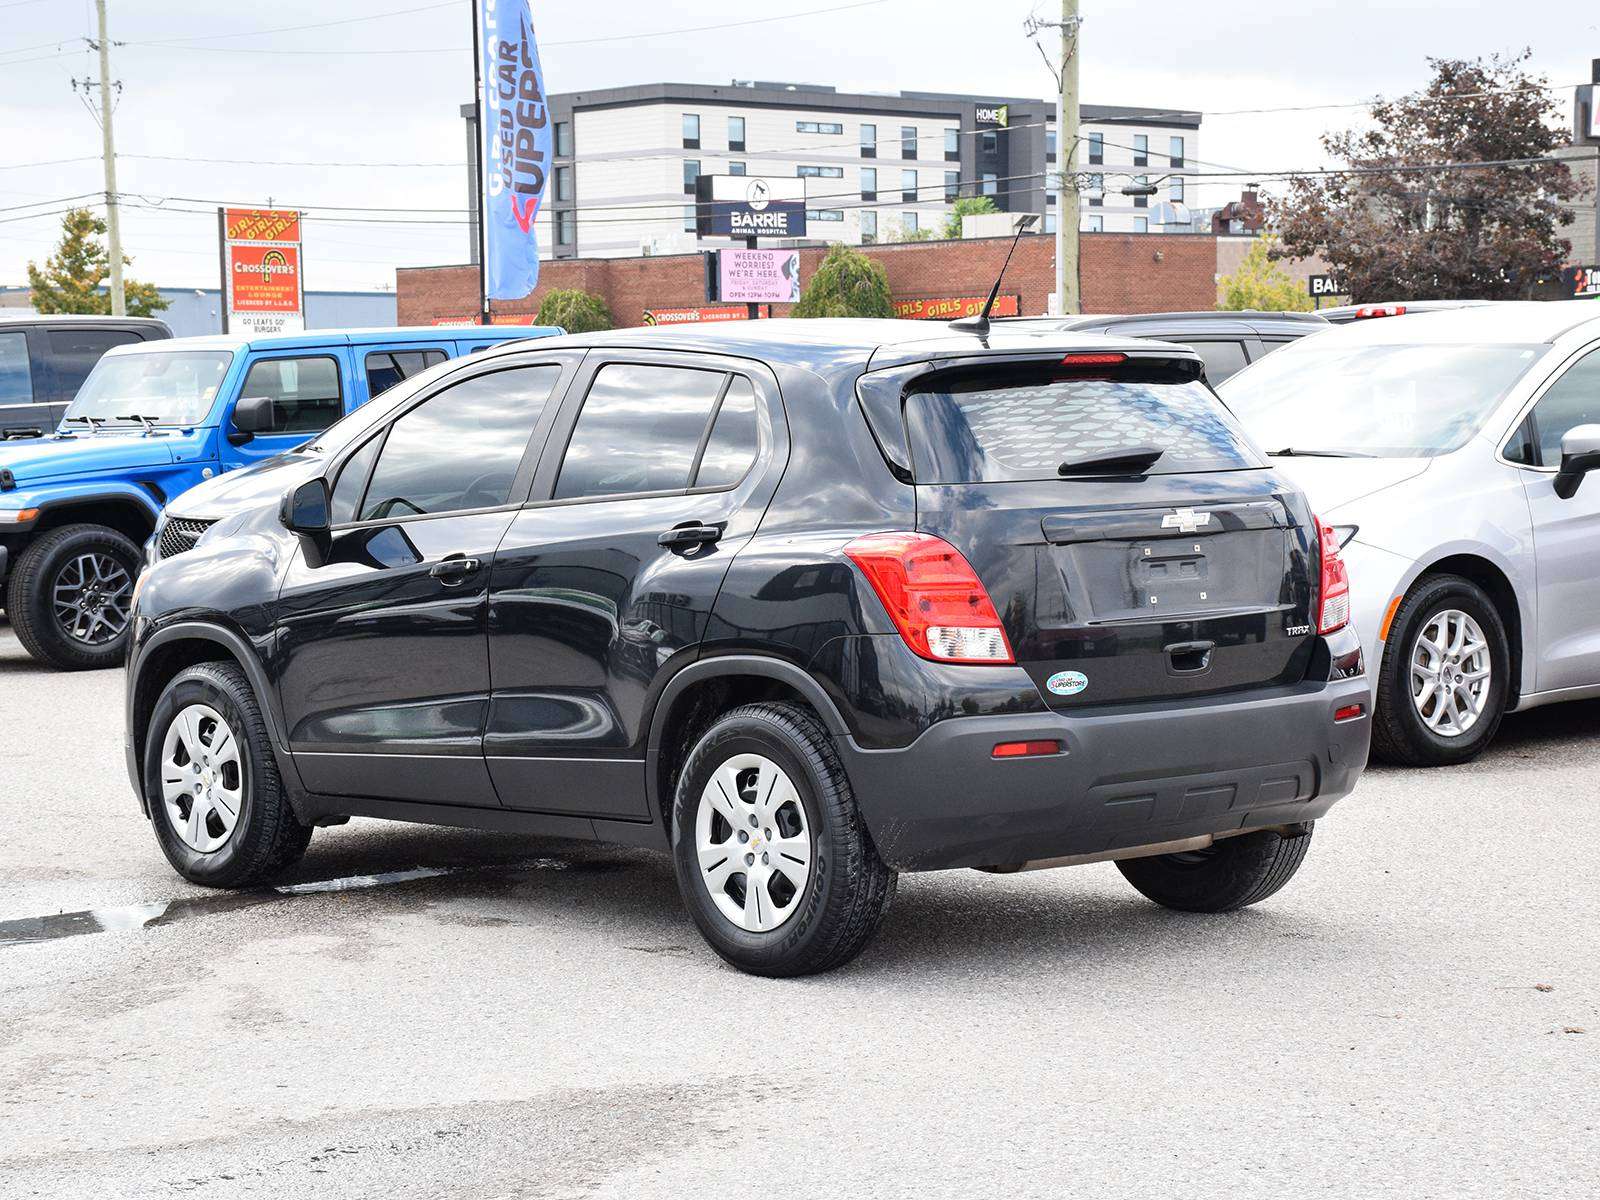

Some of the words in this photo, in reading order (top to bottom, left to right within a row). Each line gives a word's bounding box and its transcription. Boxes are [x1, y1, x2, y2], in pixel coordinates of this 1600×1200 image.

[499, 40, 518, 100] CAR
[499, 109, 514, 188] USED
[228, 210, 261, 238] GIRLS
[247, 210, 280, 240] GIRLS
[265, 211, 299, 240] GIRLS
[731, 211, 787, 228] BARRIE
[734, 253, 774, 261] WEEKEND
[734, 261, 775, 270] WORRIES?
[728, 270, 754, 278] WE'RE
[897, 301, 923, 317] IRLS
[927, 299, 962, 317] GIRLS
[253, 318, 274, 326] LEAFS
[1286, 624, 1310, 636] TRAX
